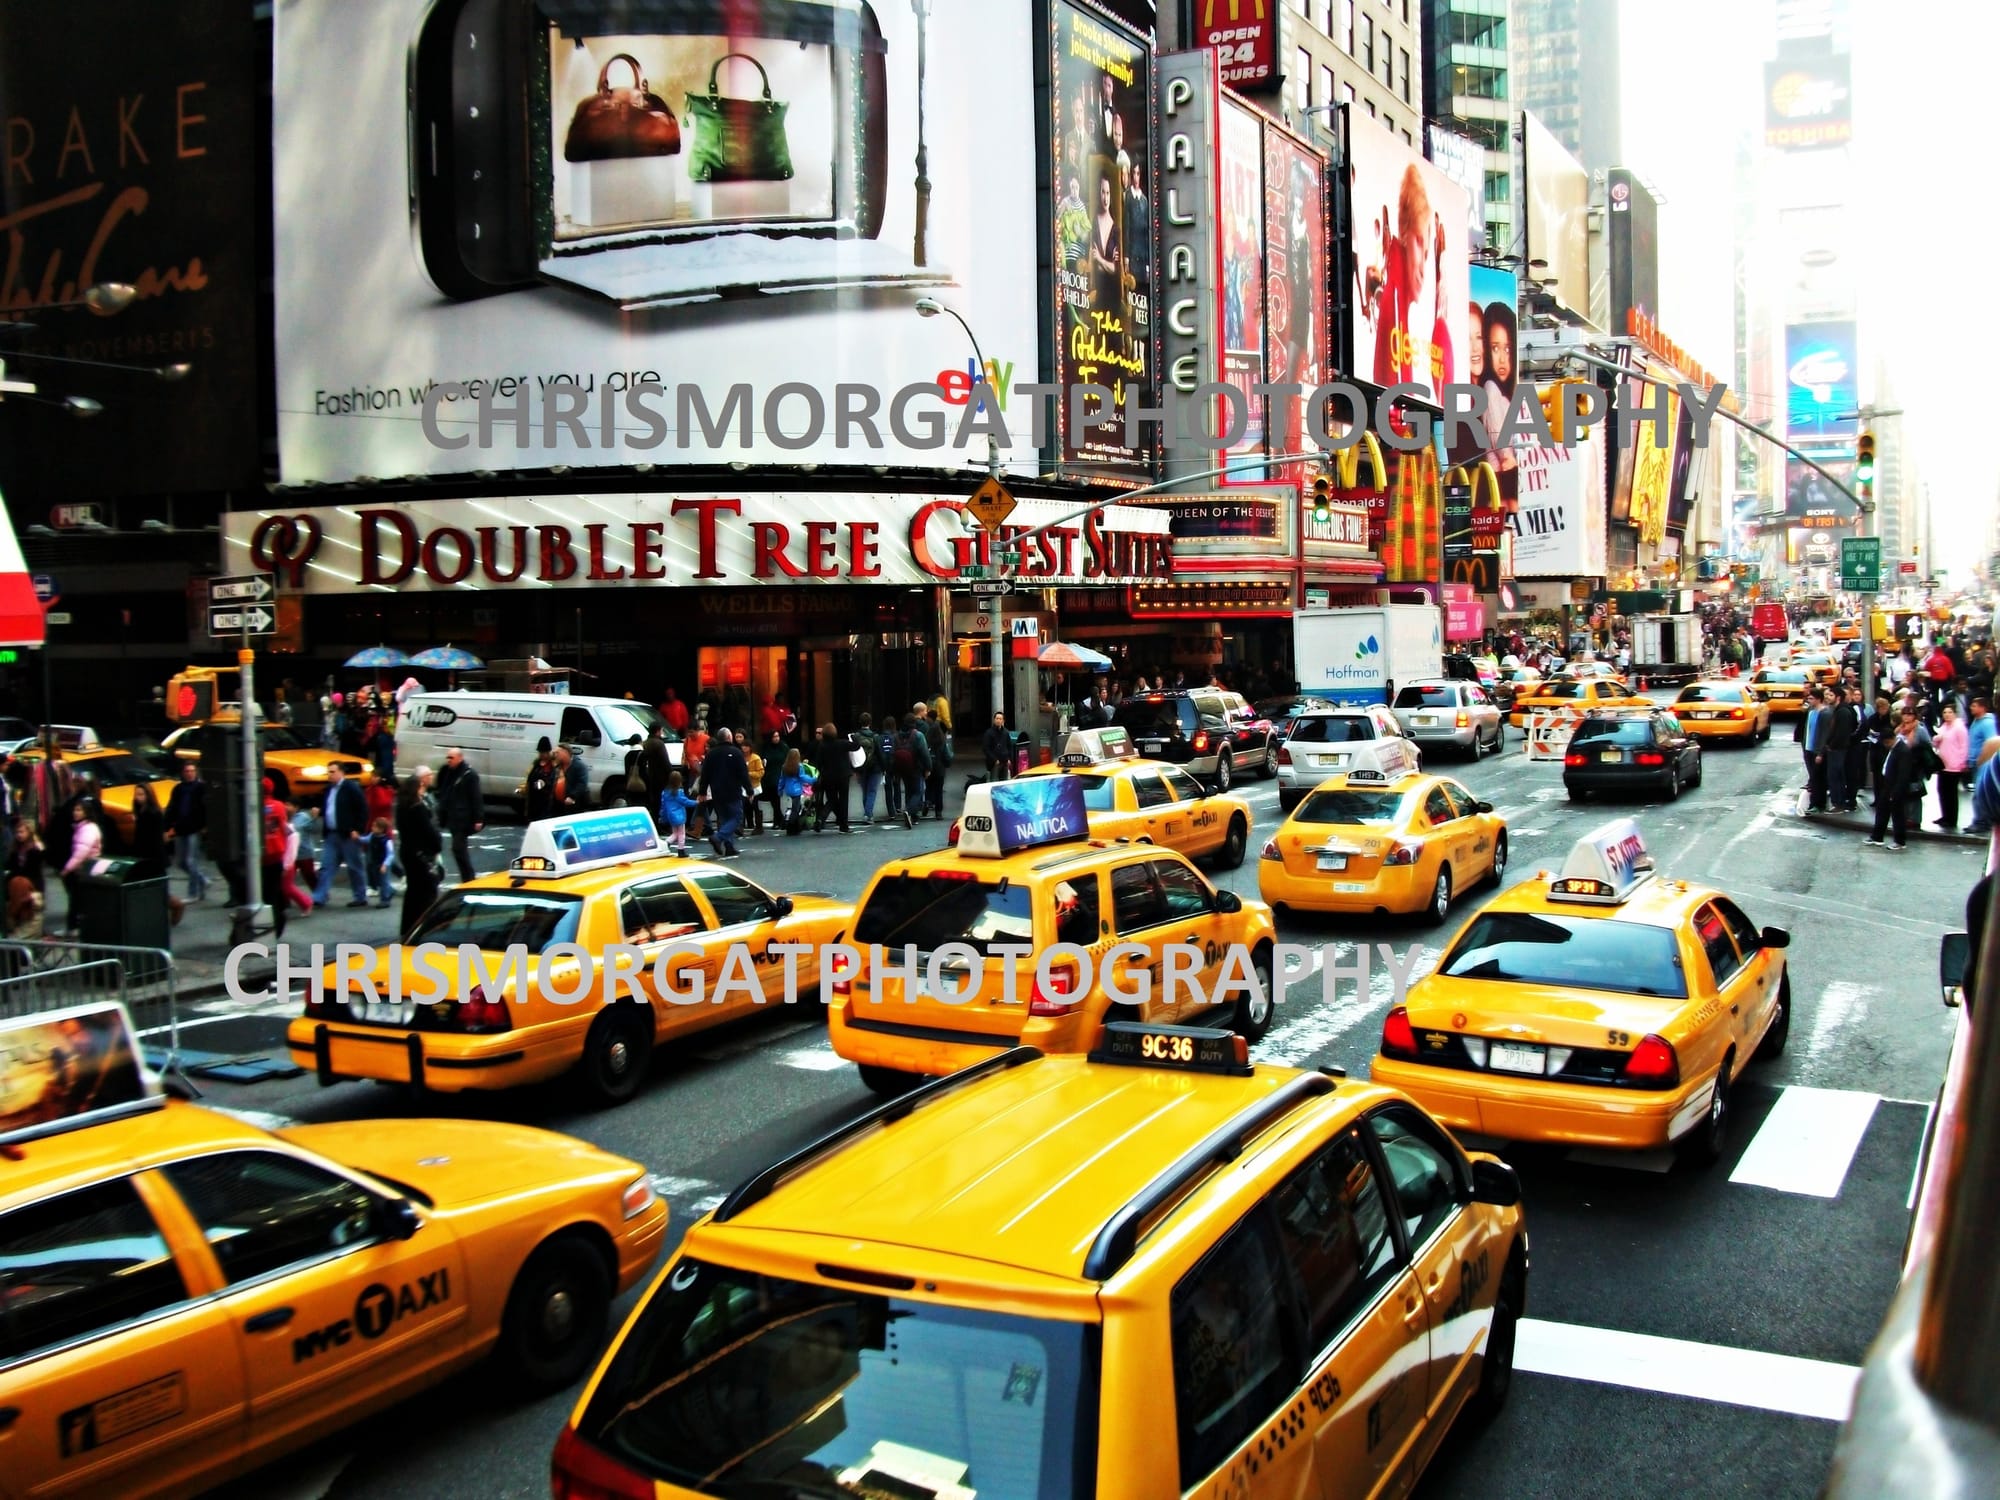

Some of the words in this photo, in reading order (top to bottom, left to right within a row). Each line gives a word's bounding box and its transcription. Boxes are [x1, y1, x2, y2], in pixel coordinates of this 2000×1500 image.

[1072, 13, 1102, 46] Brooke
[1102, 32, 1131, 63] Shields
[1208, 26, 1261, 44] OPEN
[1070, 34, 1091, 61] joins
[1092, 48, 1106, 70] the
[1106, 55, 1134, 88] family!
[1220, 41, 1256, 66] 24
[1219, 65, 1269, 83] OURS
[1612, 200, 1628, 212] LG
[1166, 77, 1198, 392] PALACE
[1061, 269, 1089, 292] BROOKE
[1062, 288, 1090, 310] SHIELDS
[1127, 291, 1148, 311] ROGER
[1090, 309, 1123, 335] The
[1135, 308, 1148, 325] REES
[1071, 325, 1143, 374] Addams
[315, 382, 402, 416] Fashion
[537, 371, 595, 404] you
[606, 369, 668, 396] are.
[1519, 443, 1571, 470] GONNA
[1526, 468, 1550, 494] IT!
[58, 504, 96, 526] FUEL
[1168, 507, 1207, 518] QUEEN
[1212, 507, 1228, 518] OF
[1233, 507, 1253, 517] THE
[1255, 508, 1274, 518] DESERT
[1527, 504, 1567, 536] MIA!
[1806, 508, 1836, 516] SONY
[1815, 515, 1836, 527] FIRST
[1843, 542, 1878, 550] SOUTHBOUND
[1845, 552, 1857, 562] USE
[1864, 553, 1876, 562] AVE
[217, 586, 237, 597] ONE
[245, 583, 263, 596] WAY
[976, 584, 989, 593] ONE
[995, 584, 1008, 593] WAY
[1843, 578, 1857, 589] BEST
[1859, 578, 1876, 589] ROUTE
[701, 593, 794, 614] WELLS
[797, 594, 858, 612] FARGO
[218, 615, 238, 627] ONE
[247, 613, 264, 625] WAY
[1325, 665, 1379, 679] Hoffman
[966, 817, 991, 832] 4K78
[1015, 816, 1069, 840] NAUTICA
[1364, 839, 1381, 848] 201
[1567, 881, 1595, 893] 3P31
[1116, 1033, 1131, 1041] OFF
[1203, 1039, 1219, 1048] OFF
[1607, 1030, 1629, 1047] 59
[1112, 1043, 1134, 1053] DUTY
[1141, 1034, 1193, 1062] 9C36
[1200, 1050, 1223, 1062] DUTY
[292, 1318, 352, 1363] NYC
[355, 1267, 450, 1340] TAXI
[1307, 1370, 1343, 1415] 9C36
